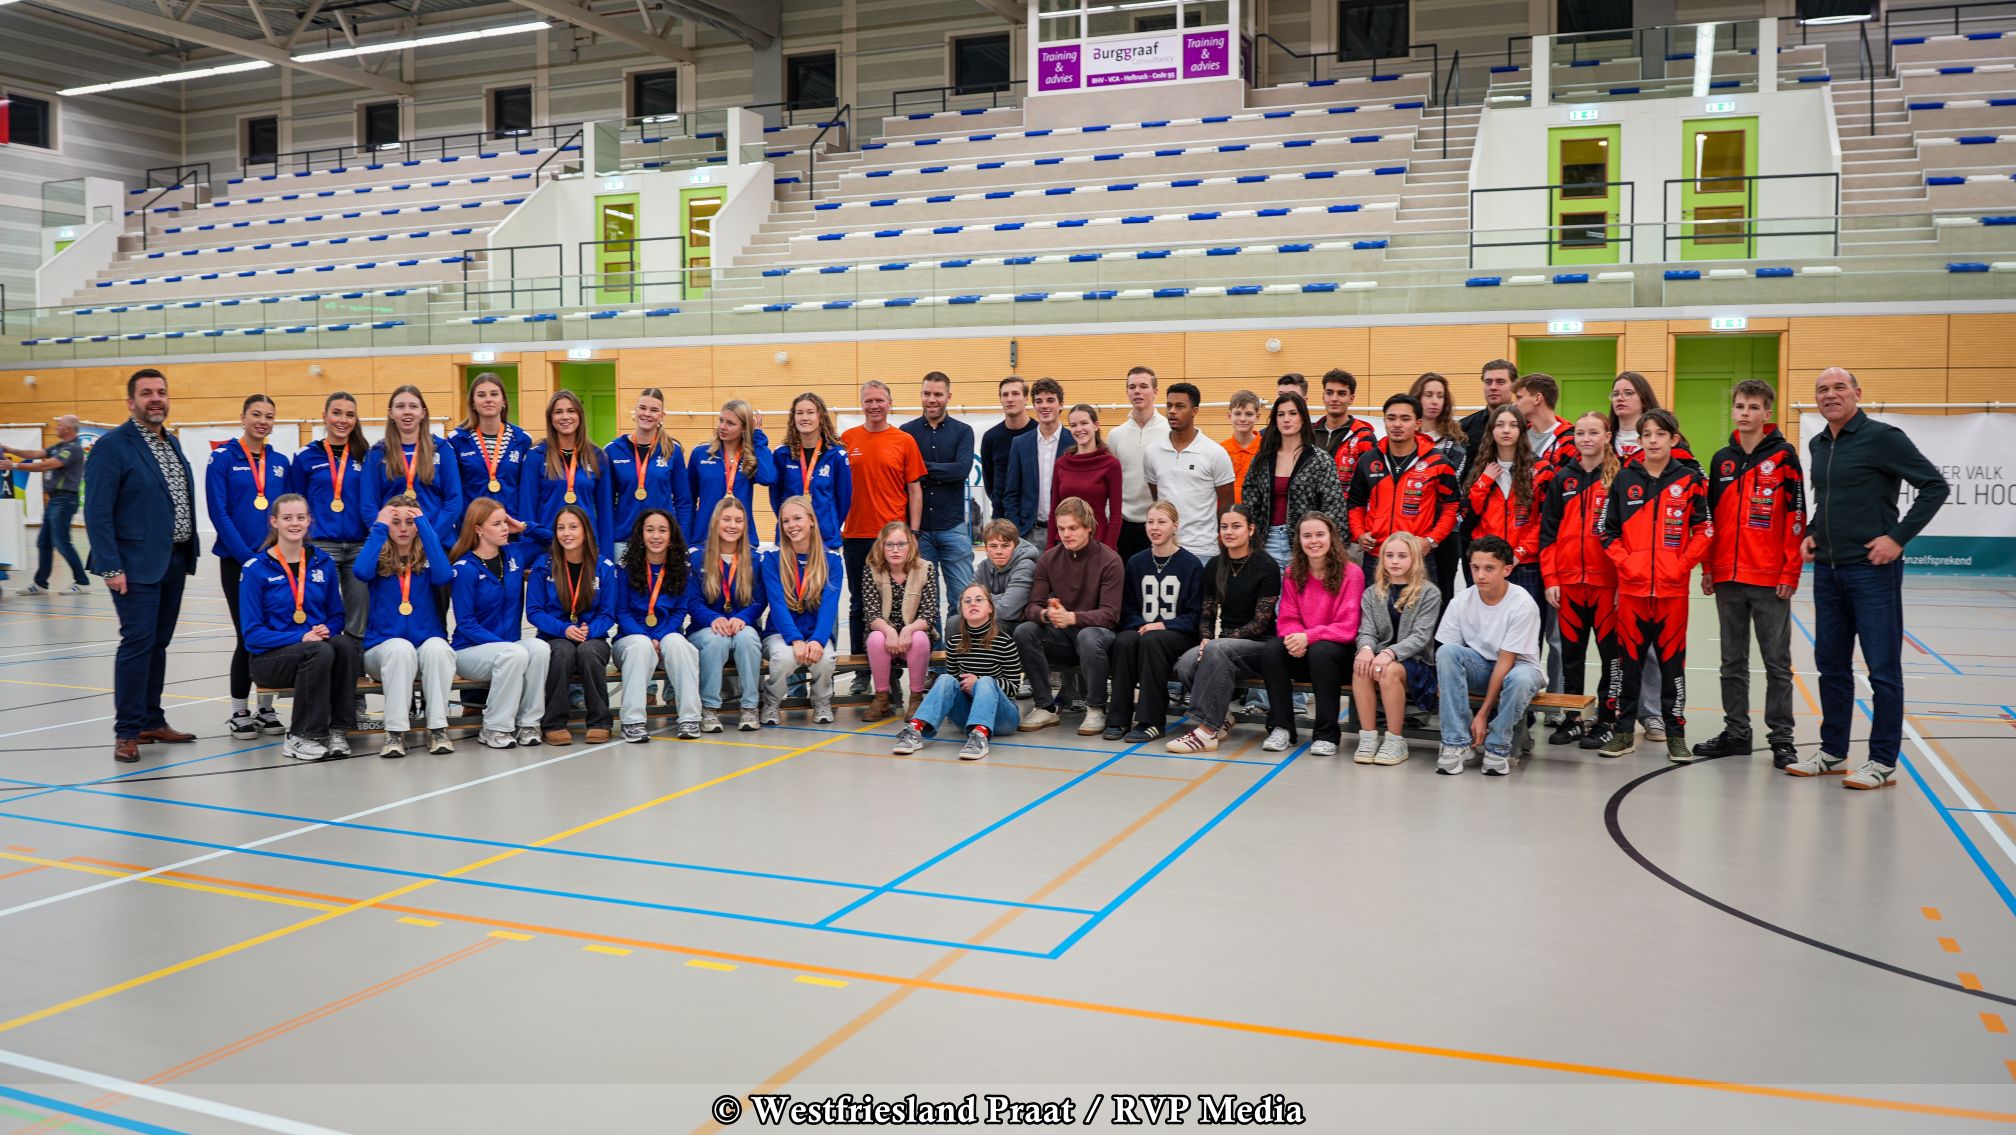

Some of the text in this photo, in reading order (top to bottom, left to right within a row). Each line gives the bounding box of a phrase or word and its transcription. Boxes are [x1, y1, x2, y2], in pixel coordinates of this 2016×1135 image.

[1187, 37, 1225, 49] Training
[1042, 51, 1077, 62] Training
[1093, 42, 1159, 61] Burggraaf
[1201, 48, 1210, 59] &
[1055, 62, 1063, 72] &
[1191, 61, 1220, 72] advies
[1045, 74, 1073, 84] advies
[1123, 73, 1149, 81] Heftruck
[1152, 71, 1167, 79] Code
[1939, 466, 2004, 480] ER VALK
[1902, 555, 1972, 567] anzelfsprekend
[1141, 575, 1181, 622] 89
